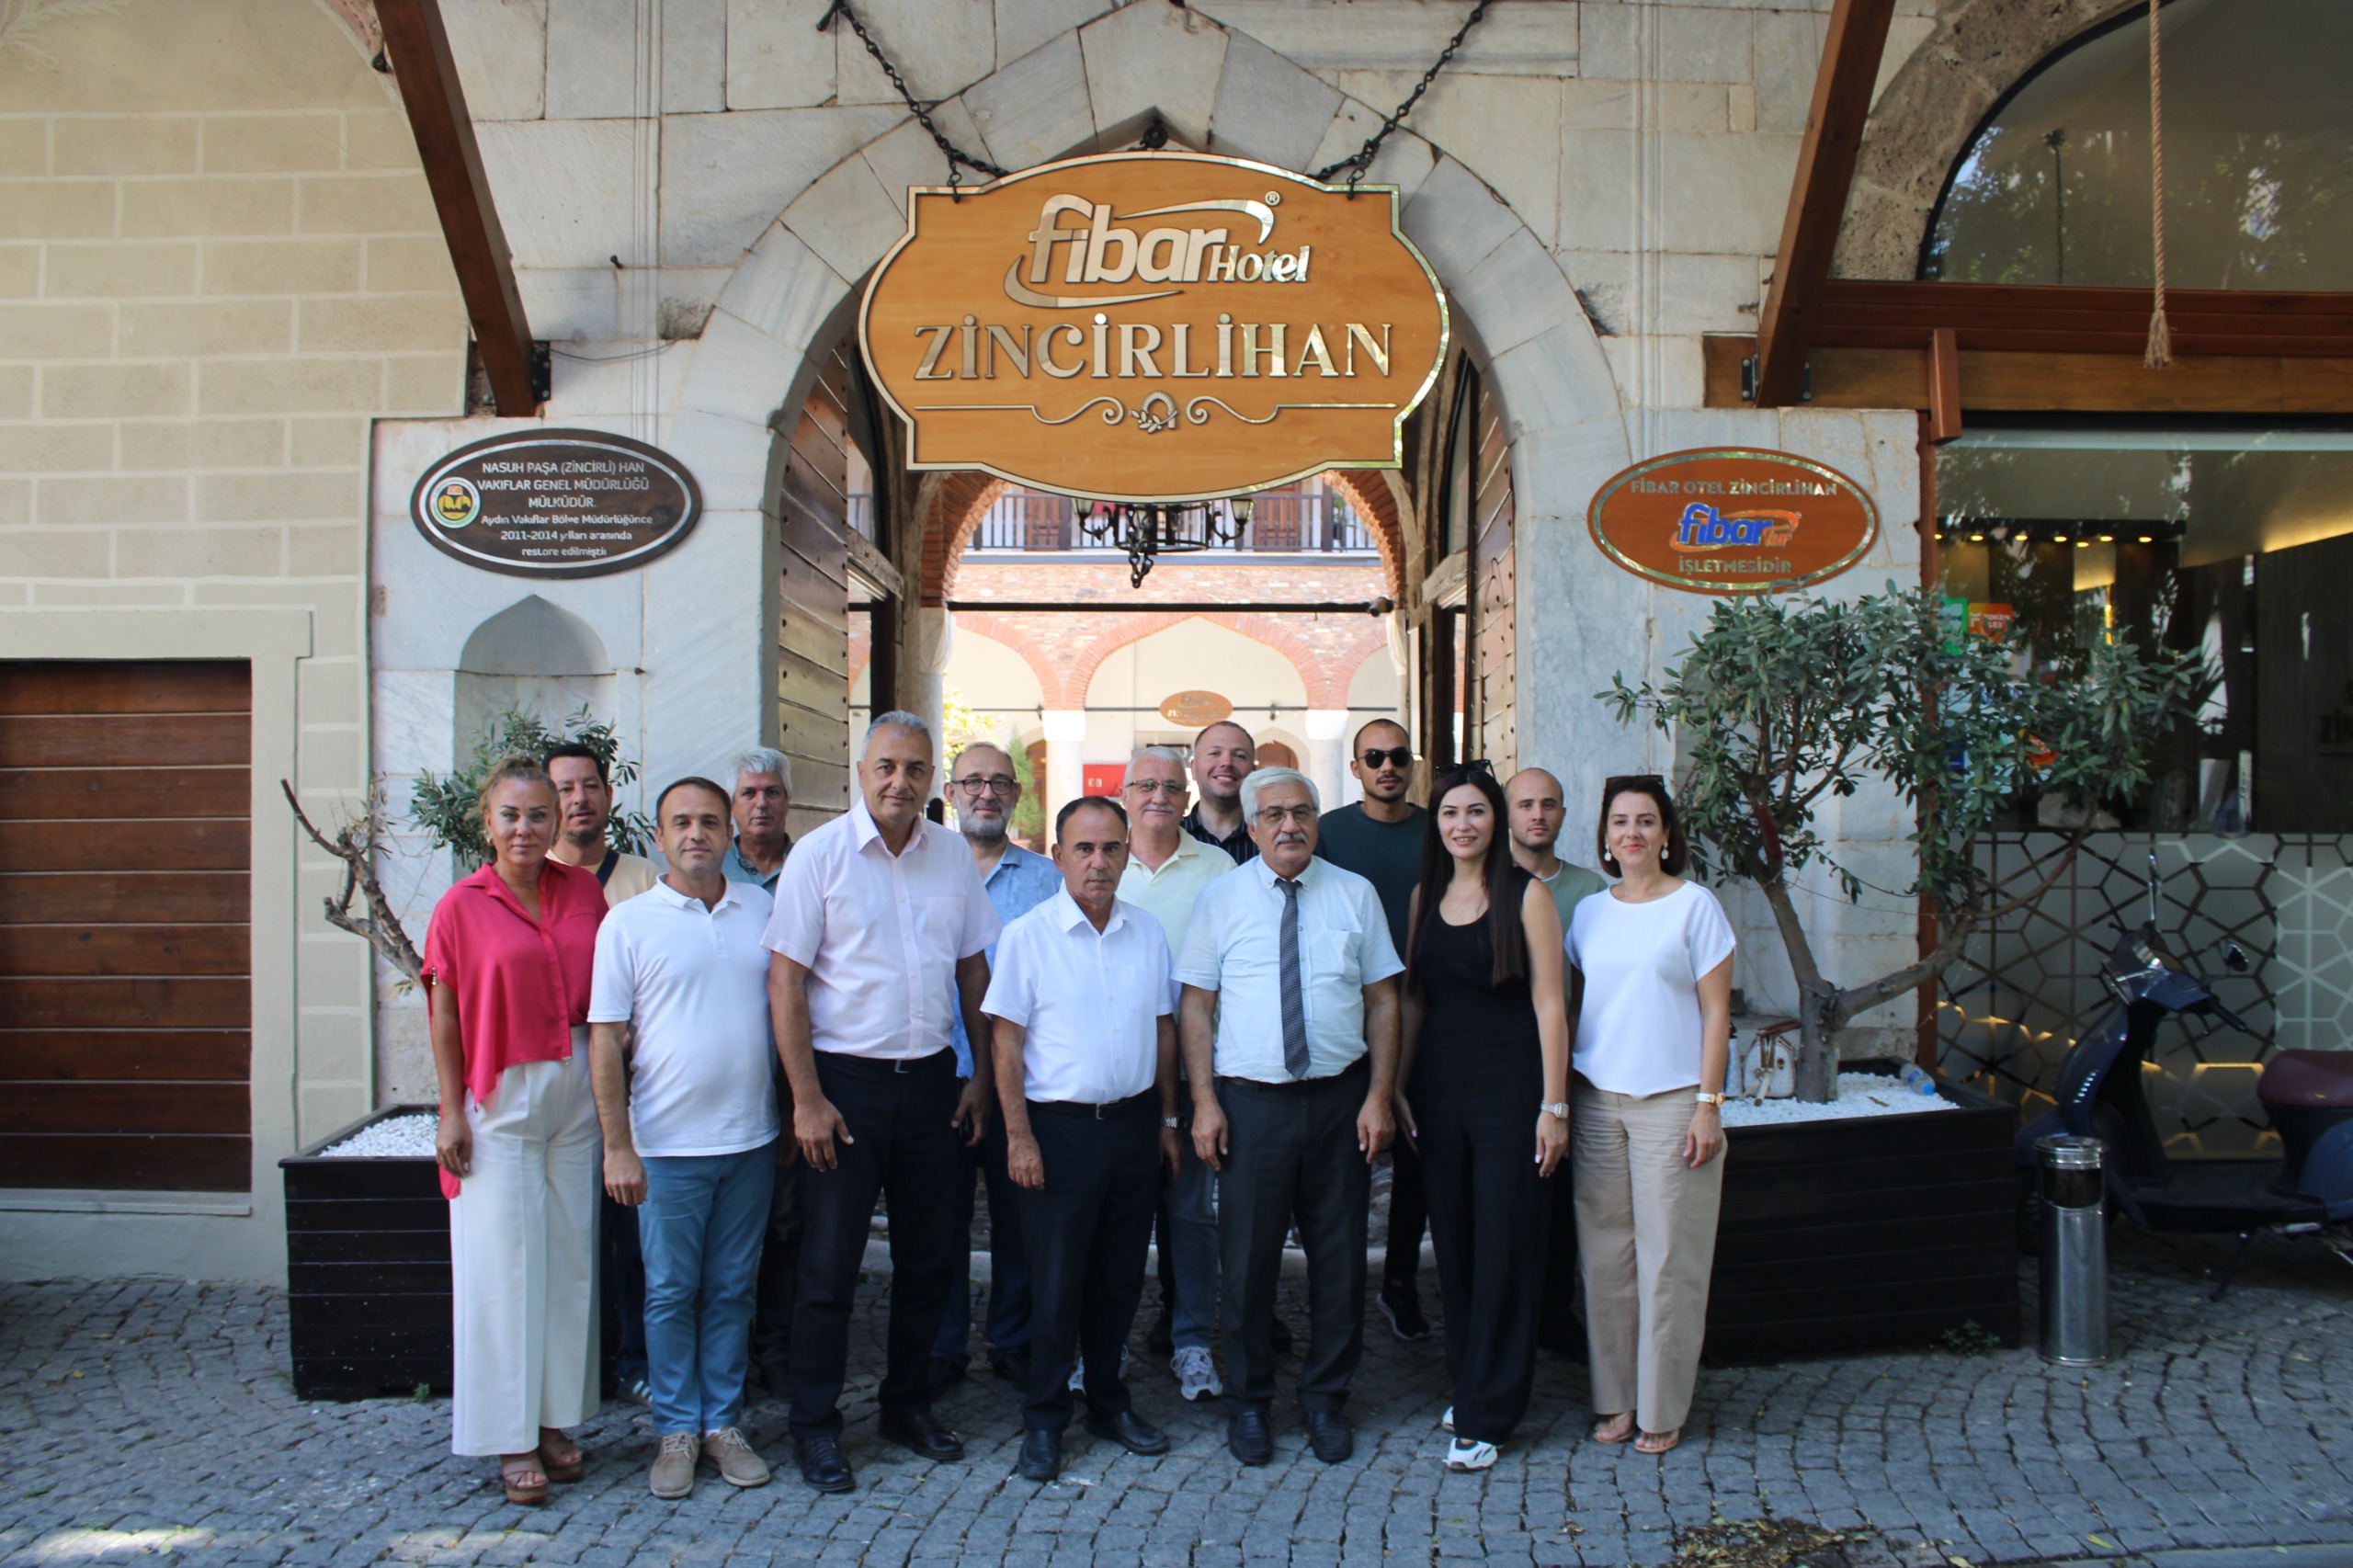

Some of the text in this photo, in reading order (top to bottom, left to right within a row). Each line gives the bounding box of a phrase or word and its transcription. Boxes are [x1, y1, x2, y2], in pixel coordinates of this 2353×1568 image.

[1029, 193, 1312, 283] fibar Hotel
[914, 312, 1392, 380] ZİNCİRLİHAN
[482, 460, 645, 475] NASUH PAŞA (ZİNCİRLİ) HAN
[477, 479, 531, 491] VAKIFLAR
[533, 479, 572, 491] GENEL
[574, 477, 650, 491] MÜDÜRLÜĞÜ
[1631, 478, 1837, 495] FİBAR OTEL ZİNCİRLİHAN
[481, 515, 509, 527] Aydın
[511, 514, 550, 525] Vakıflar
[582, 514, 653, 527] Müdürlüğünce
[1679, 502, 1774, 545] fibar
[500, 530, 558, 540] 2011-2014
[589, 530, 632, 540] arasında
[521, 547, 560, 556] restore
[1678, 556, 1791, 575] İŞLETMESİDİR
